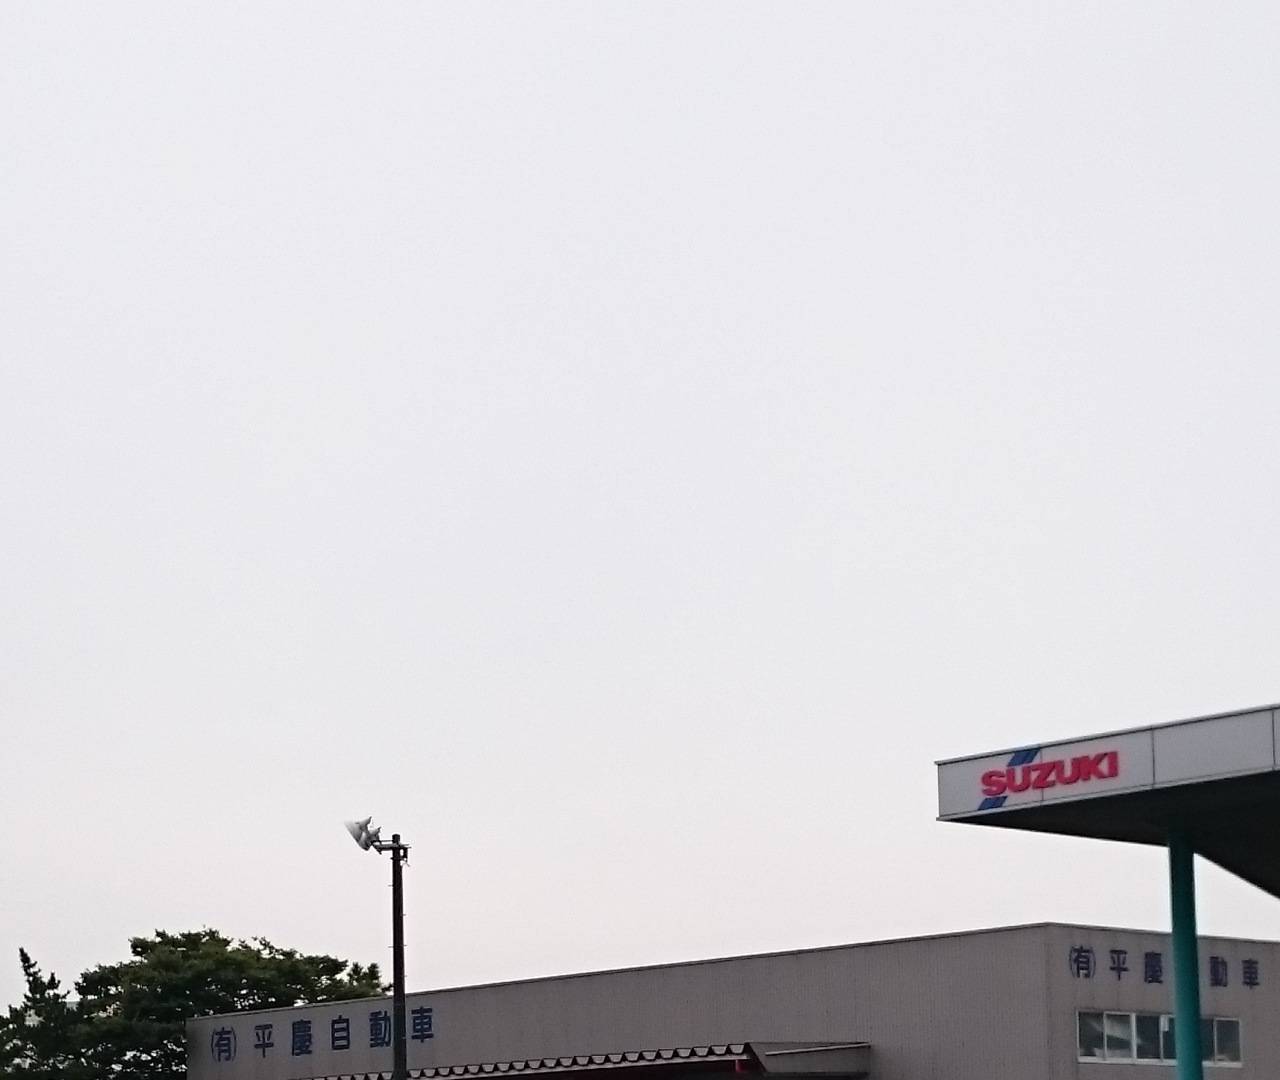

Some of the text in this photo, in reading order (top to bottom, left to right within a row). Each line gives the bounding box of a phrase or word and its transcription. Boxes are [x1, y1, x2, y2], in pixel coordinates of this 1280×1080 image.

[981, 751, 1118, 797] SUZUKI
[1069, 944, 1261, 989] (有)平慶動車
